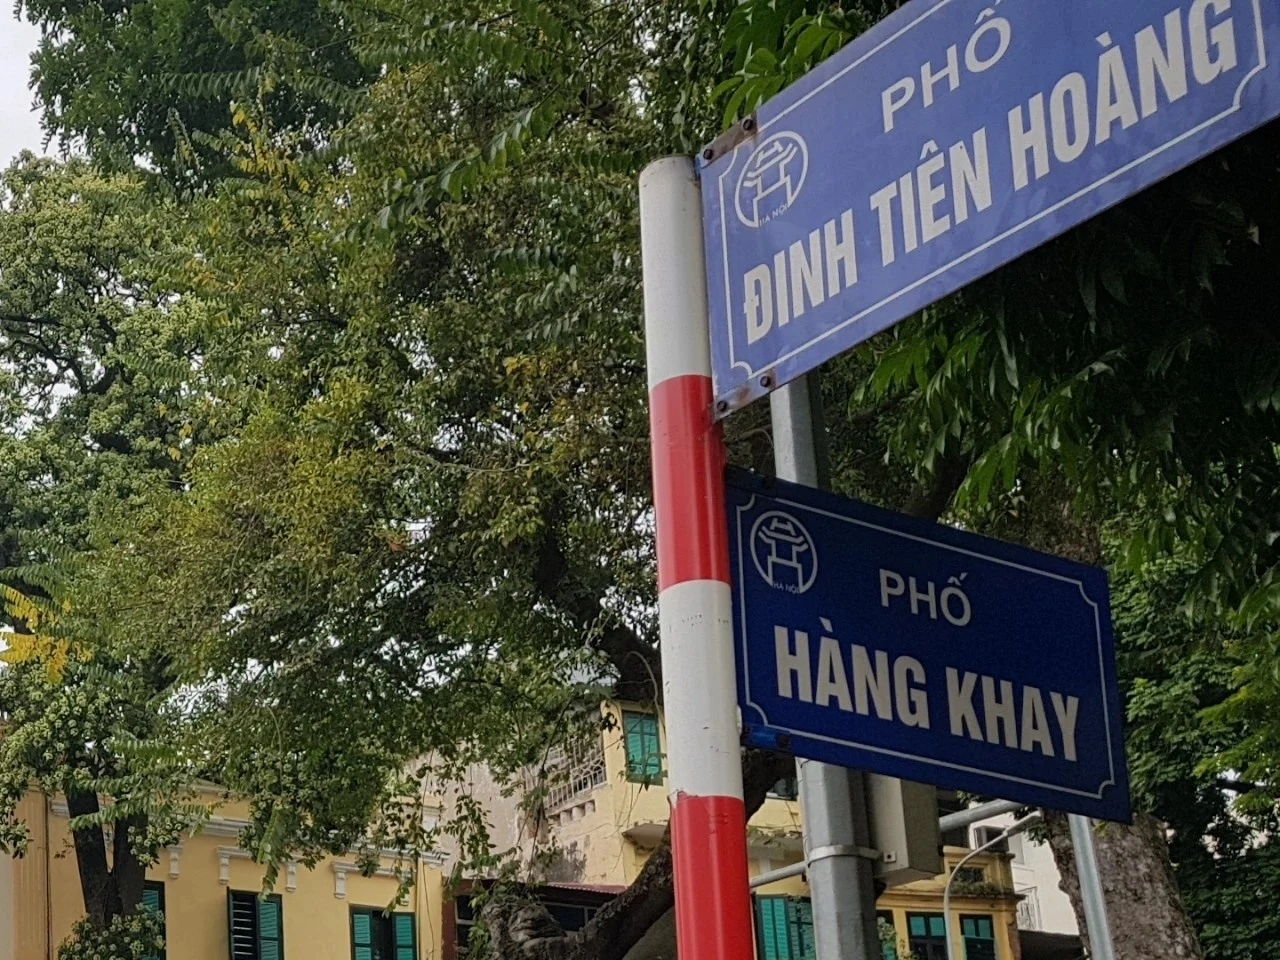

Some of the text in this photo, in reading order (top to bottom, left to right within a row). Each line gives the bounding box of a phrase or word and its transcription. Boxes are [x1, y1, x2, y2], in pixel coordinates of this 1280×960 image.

[882, 0, 1012, 134] PHỐ
[742, 0, 1238, 345] ĐINH TIÊN HOÀNG
[879, 568, 972, 627] PHỐ
[773, 616, 1080, 763] HÀNG KHAY
